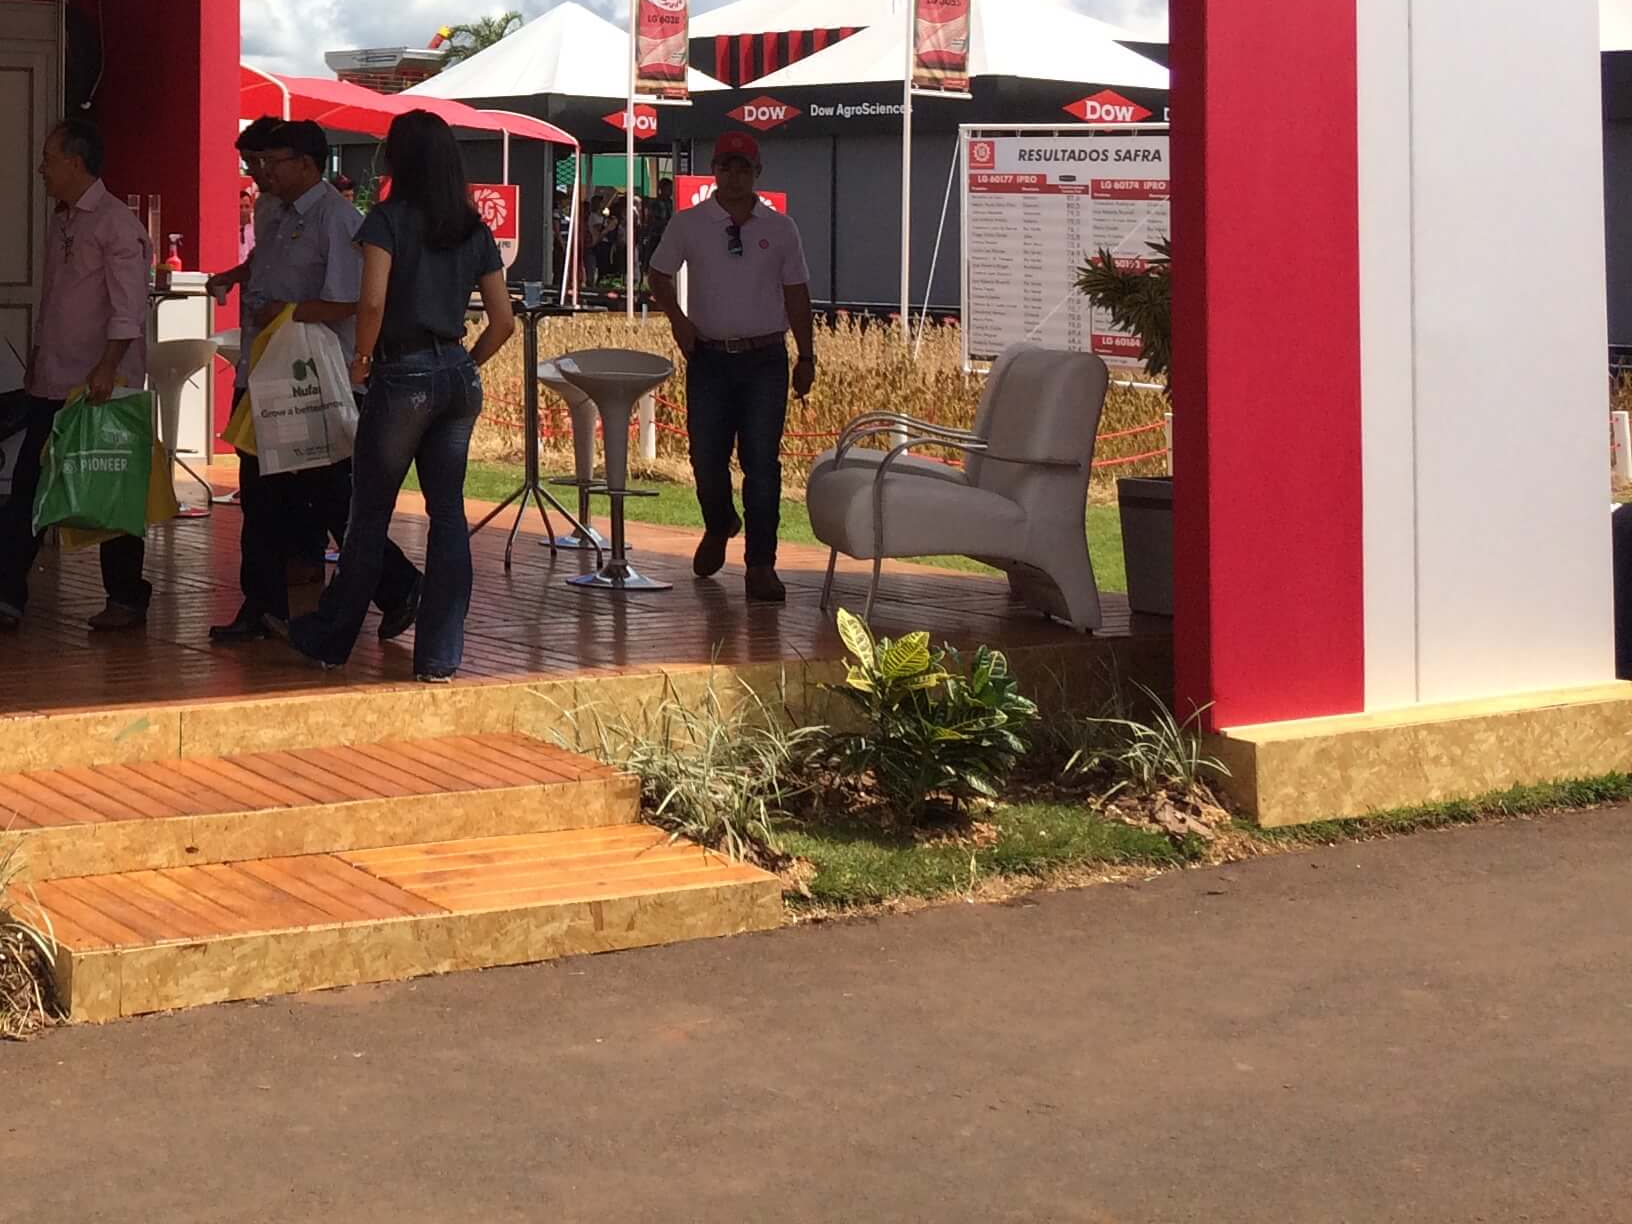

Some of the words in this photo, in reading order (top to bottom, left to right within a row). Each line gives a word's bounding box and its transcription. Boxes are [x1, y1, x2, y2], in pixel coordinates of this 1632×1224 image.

[810, 103, 834, 116] Dow
[1018, 148, 1109, 162] RESULTADOS
[1113, 149, 1162, 162] SAFRA
[81, 456, 128, 473] PIONEER
